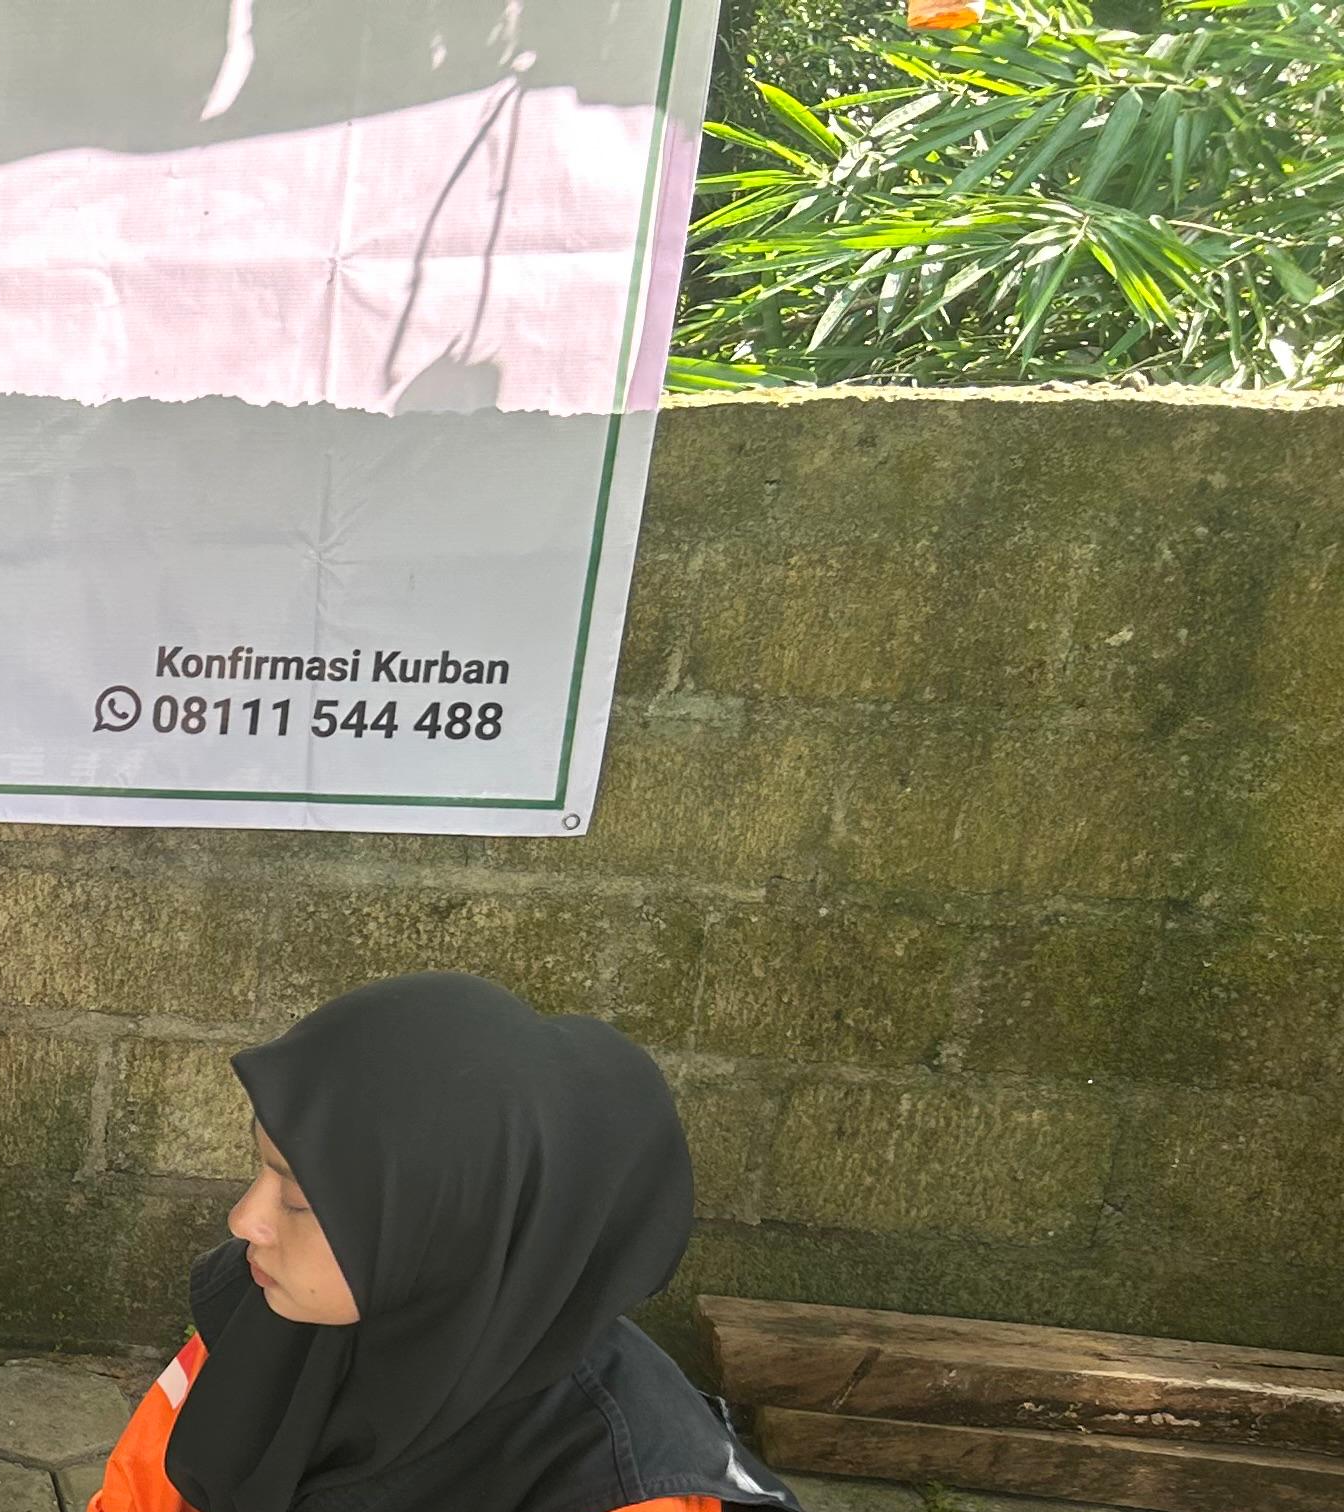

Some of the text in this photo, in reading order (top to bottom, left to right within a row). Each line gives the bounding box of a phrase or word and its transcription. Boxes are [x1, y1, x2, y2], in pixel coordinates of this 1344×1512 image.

[155, 645, 510, 686] Konfirmasi Kurban
[152, 694, 504, 741] 08111 544 488
